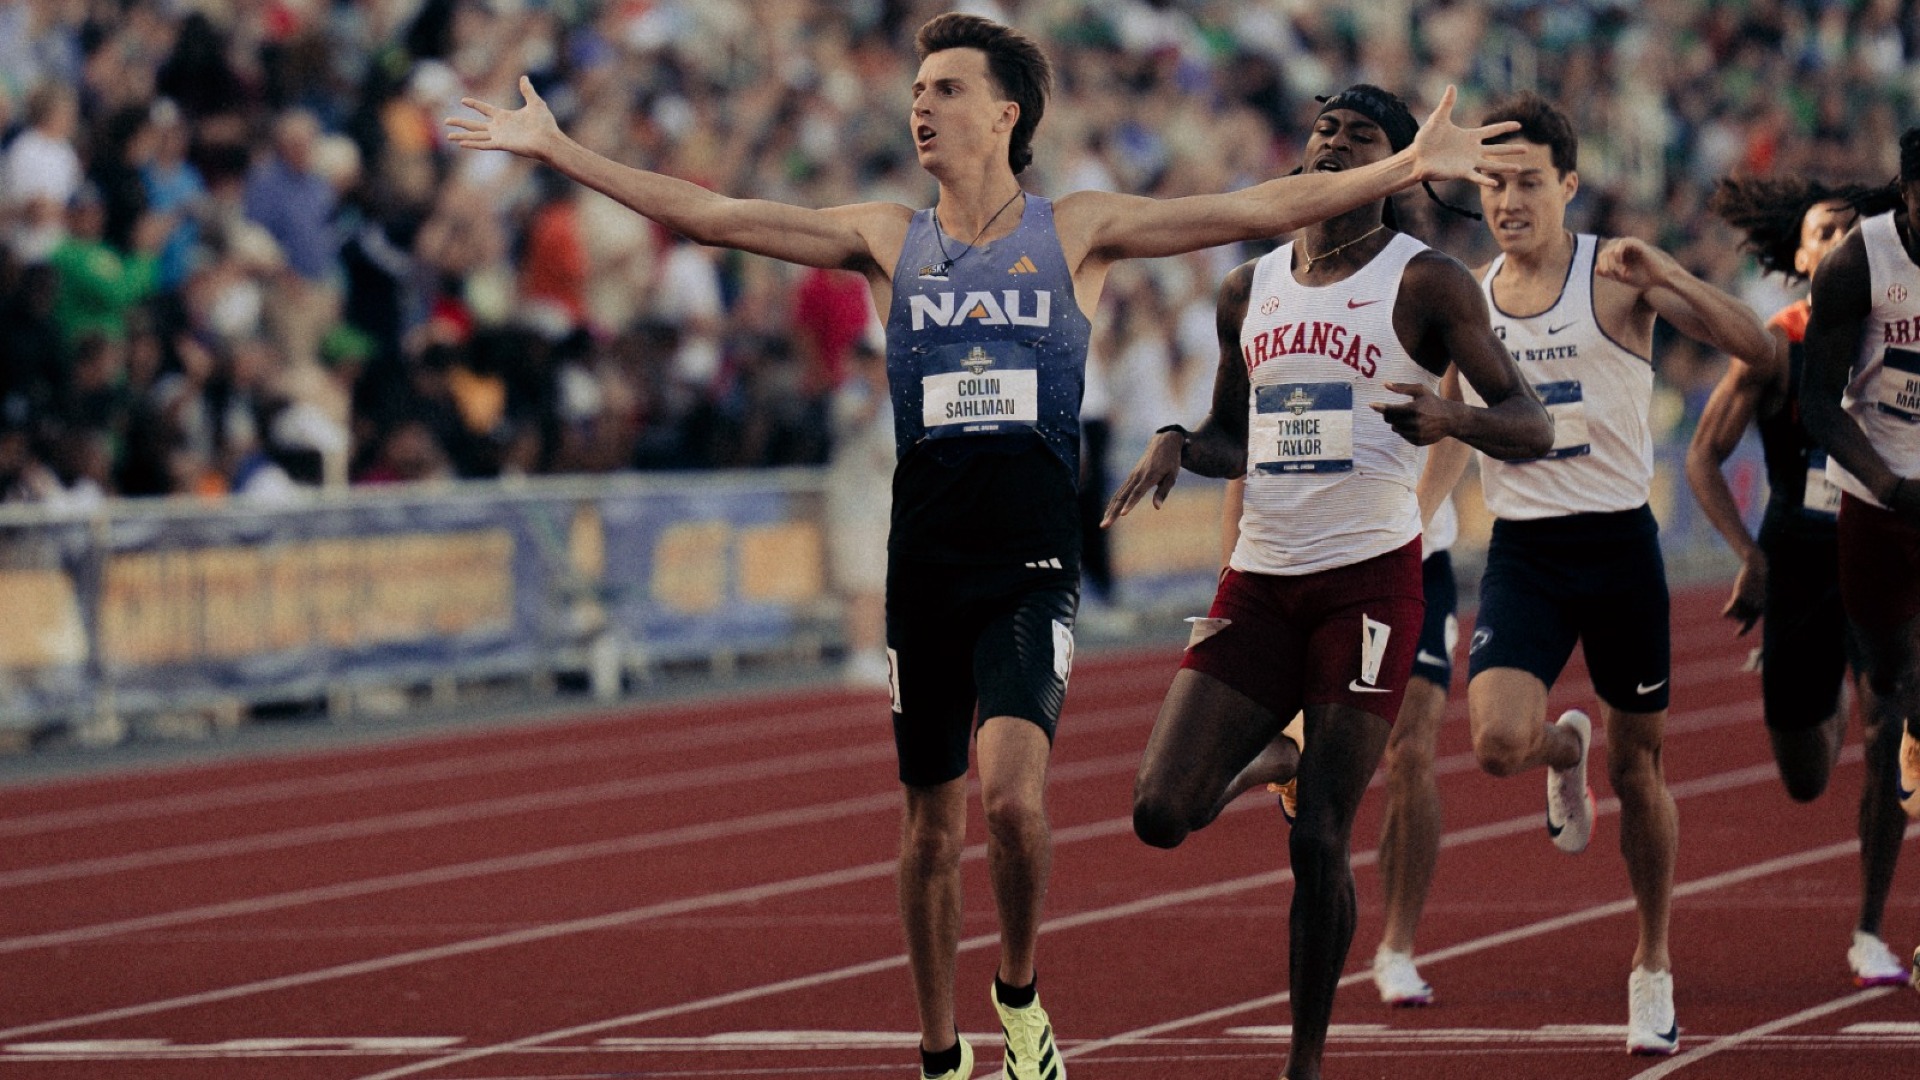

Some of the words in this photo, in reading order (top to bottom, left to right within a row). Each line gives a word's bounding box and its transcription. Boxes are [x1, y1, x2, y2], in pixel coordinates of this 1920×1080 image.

[908, 289, 1051, 331] NAU
[1525, 344, 1578, 361] STATE
[958, 378, 1001, 397] COLIN
[946, 398, 1015, 419] SAHLMAN
[1278, 418, 1321, 436] TYRICE
[1277, 438, 1322, 456] TAYLOR
